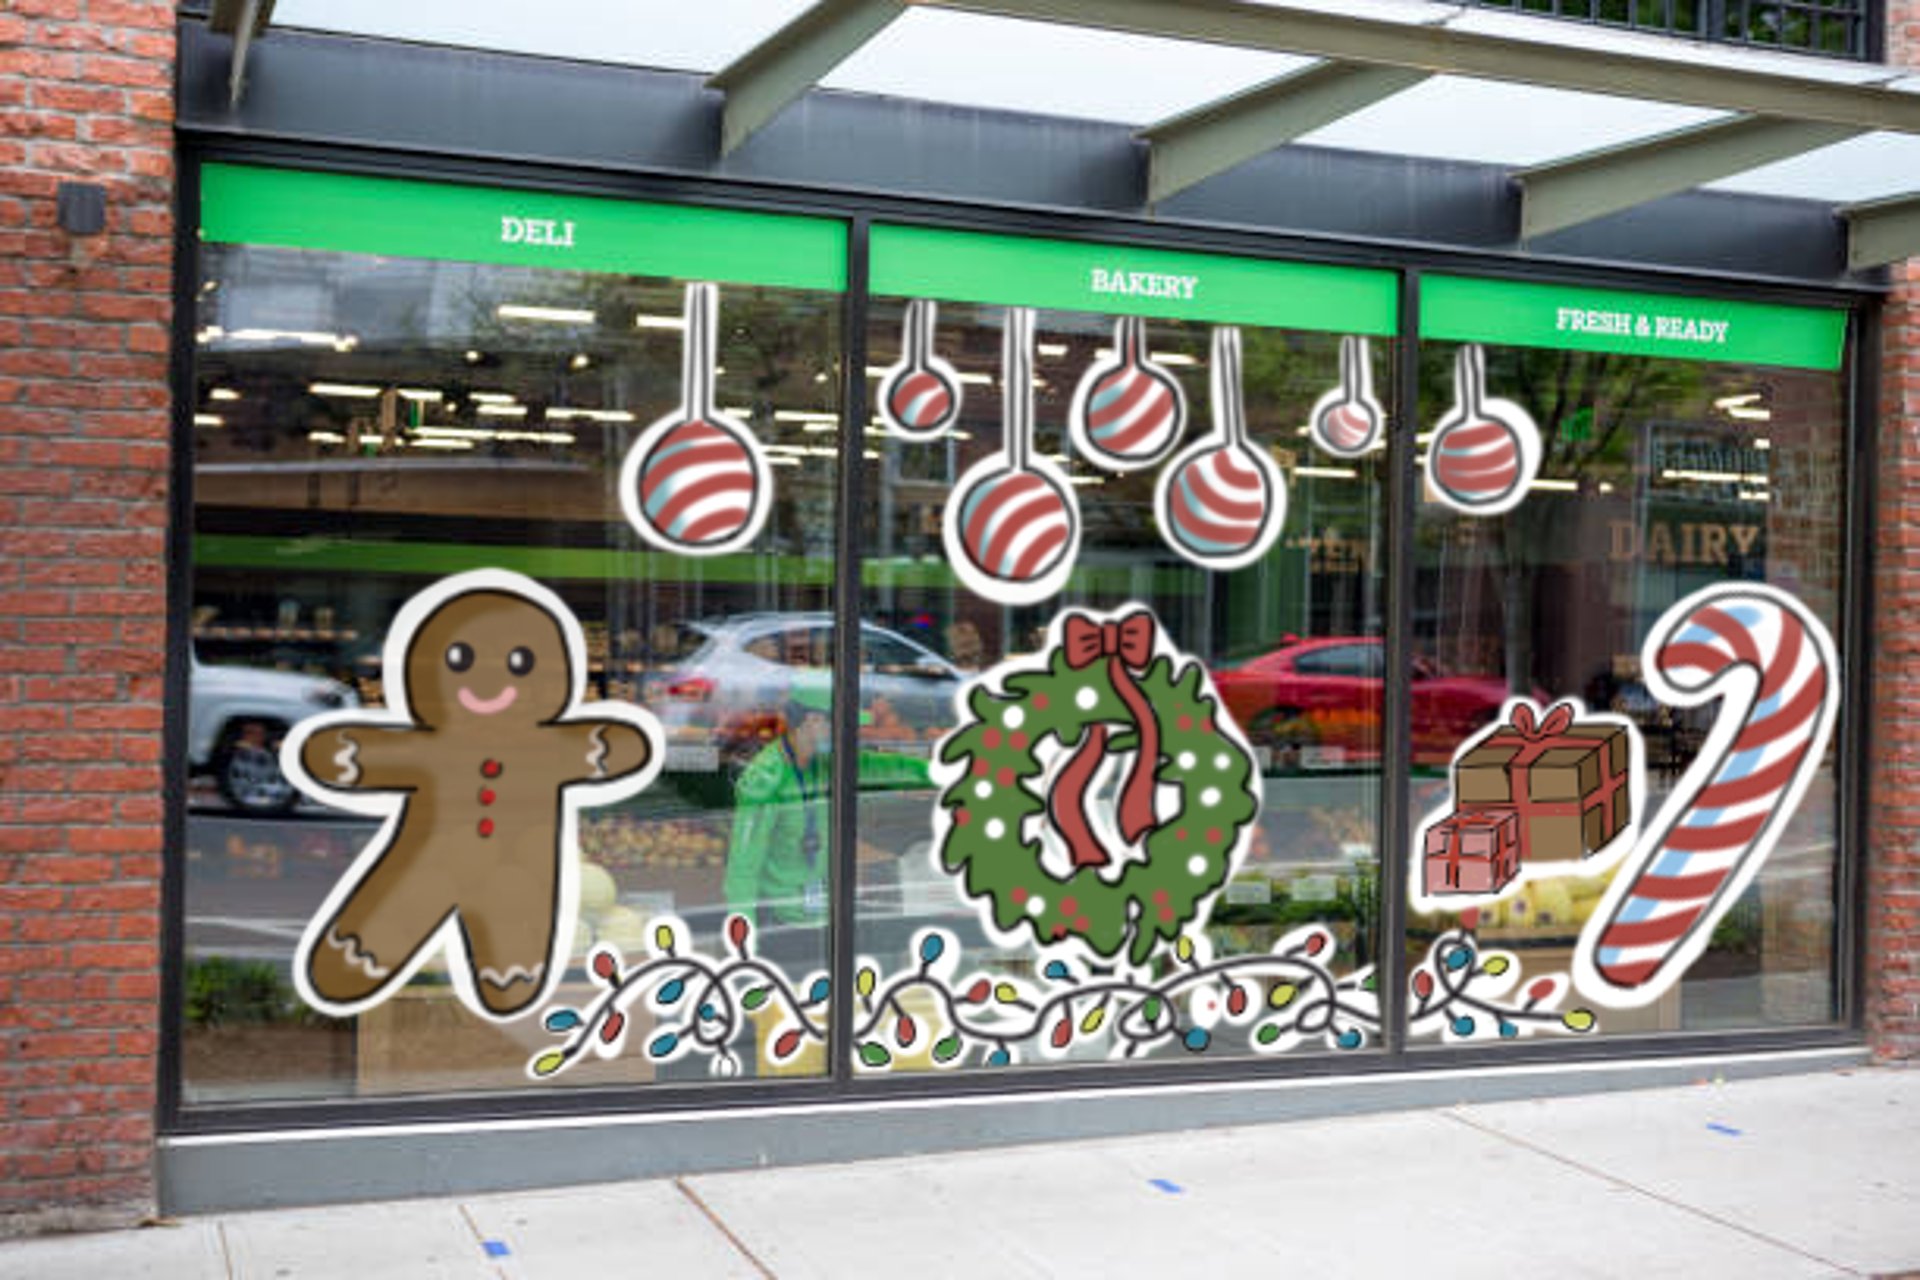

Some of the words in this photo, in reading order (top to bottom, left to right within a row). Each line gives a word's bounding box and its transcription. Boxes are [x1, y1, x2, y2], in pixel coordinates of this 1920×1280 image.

[501, 216, 576, 247] DELI
[1091, 268, 1199, 299] BAKERY
[1556, 307, 1631, 335] FRESH
[1635, 314, 1650, 337] &
[1655, 316, 1730, 343] READY
[1608, 520, 1759, 567] DAIRY
